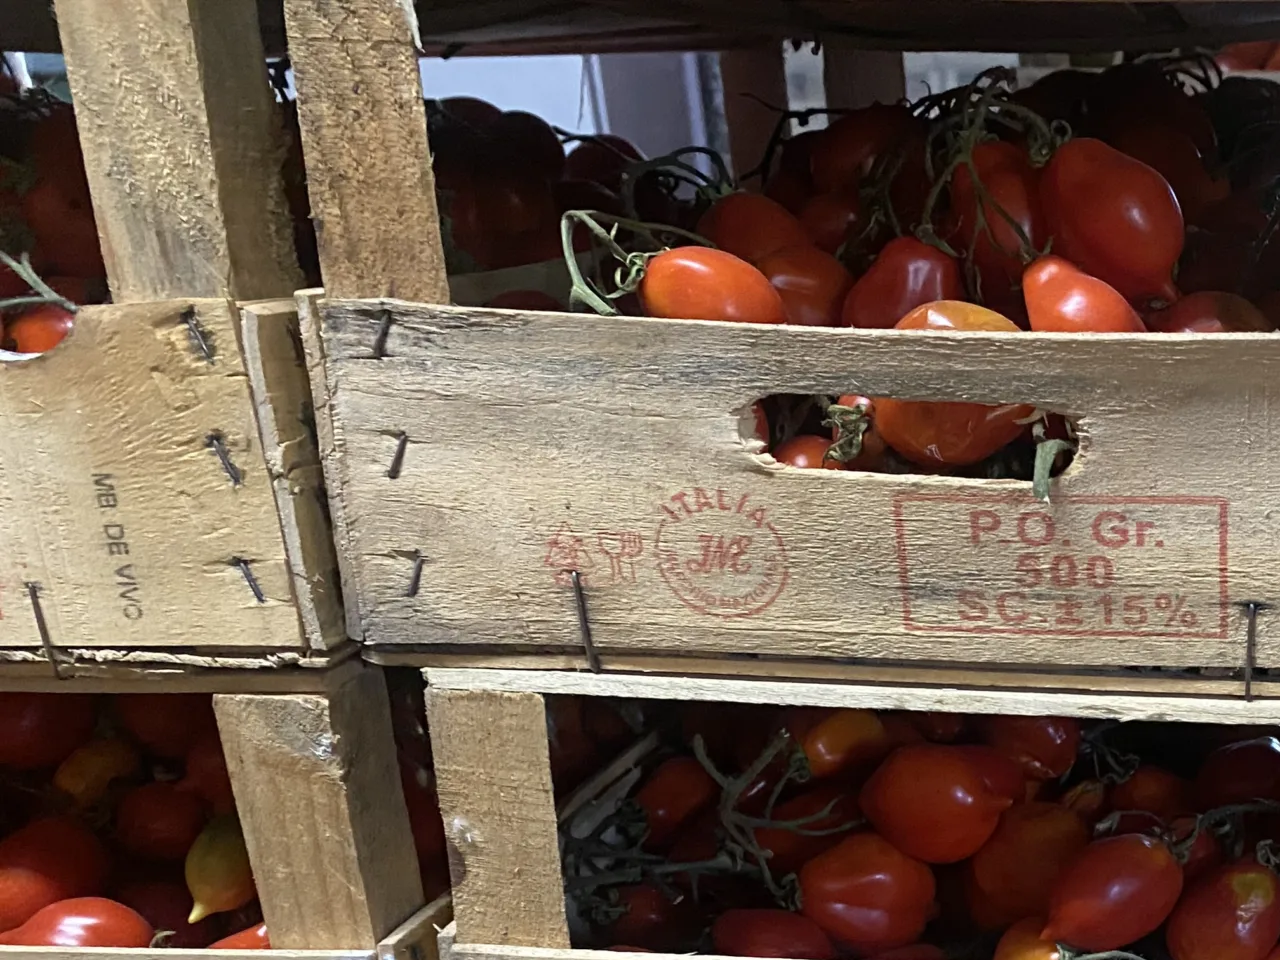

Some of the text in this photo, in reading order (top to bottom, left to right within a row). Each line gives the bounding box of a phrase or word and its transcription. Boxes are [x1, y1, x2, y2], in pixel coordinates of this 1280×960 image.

[659, 487, 767, 529] ITALIA
[103, 524, 130, 556] DE
[1091, 510, 1165, 548] Gr.
[1015, 554, 1115, 589] 500
[114, 564, 143, 621] VIVO
